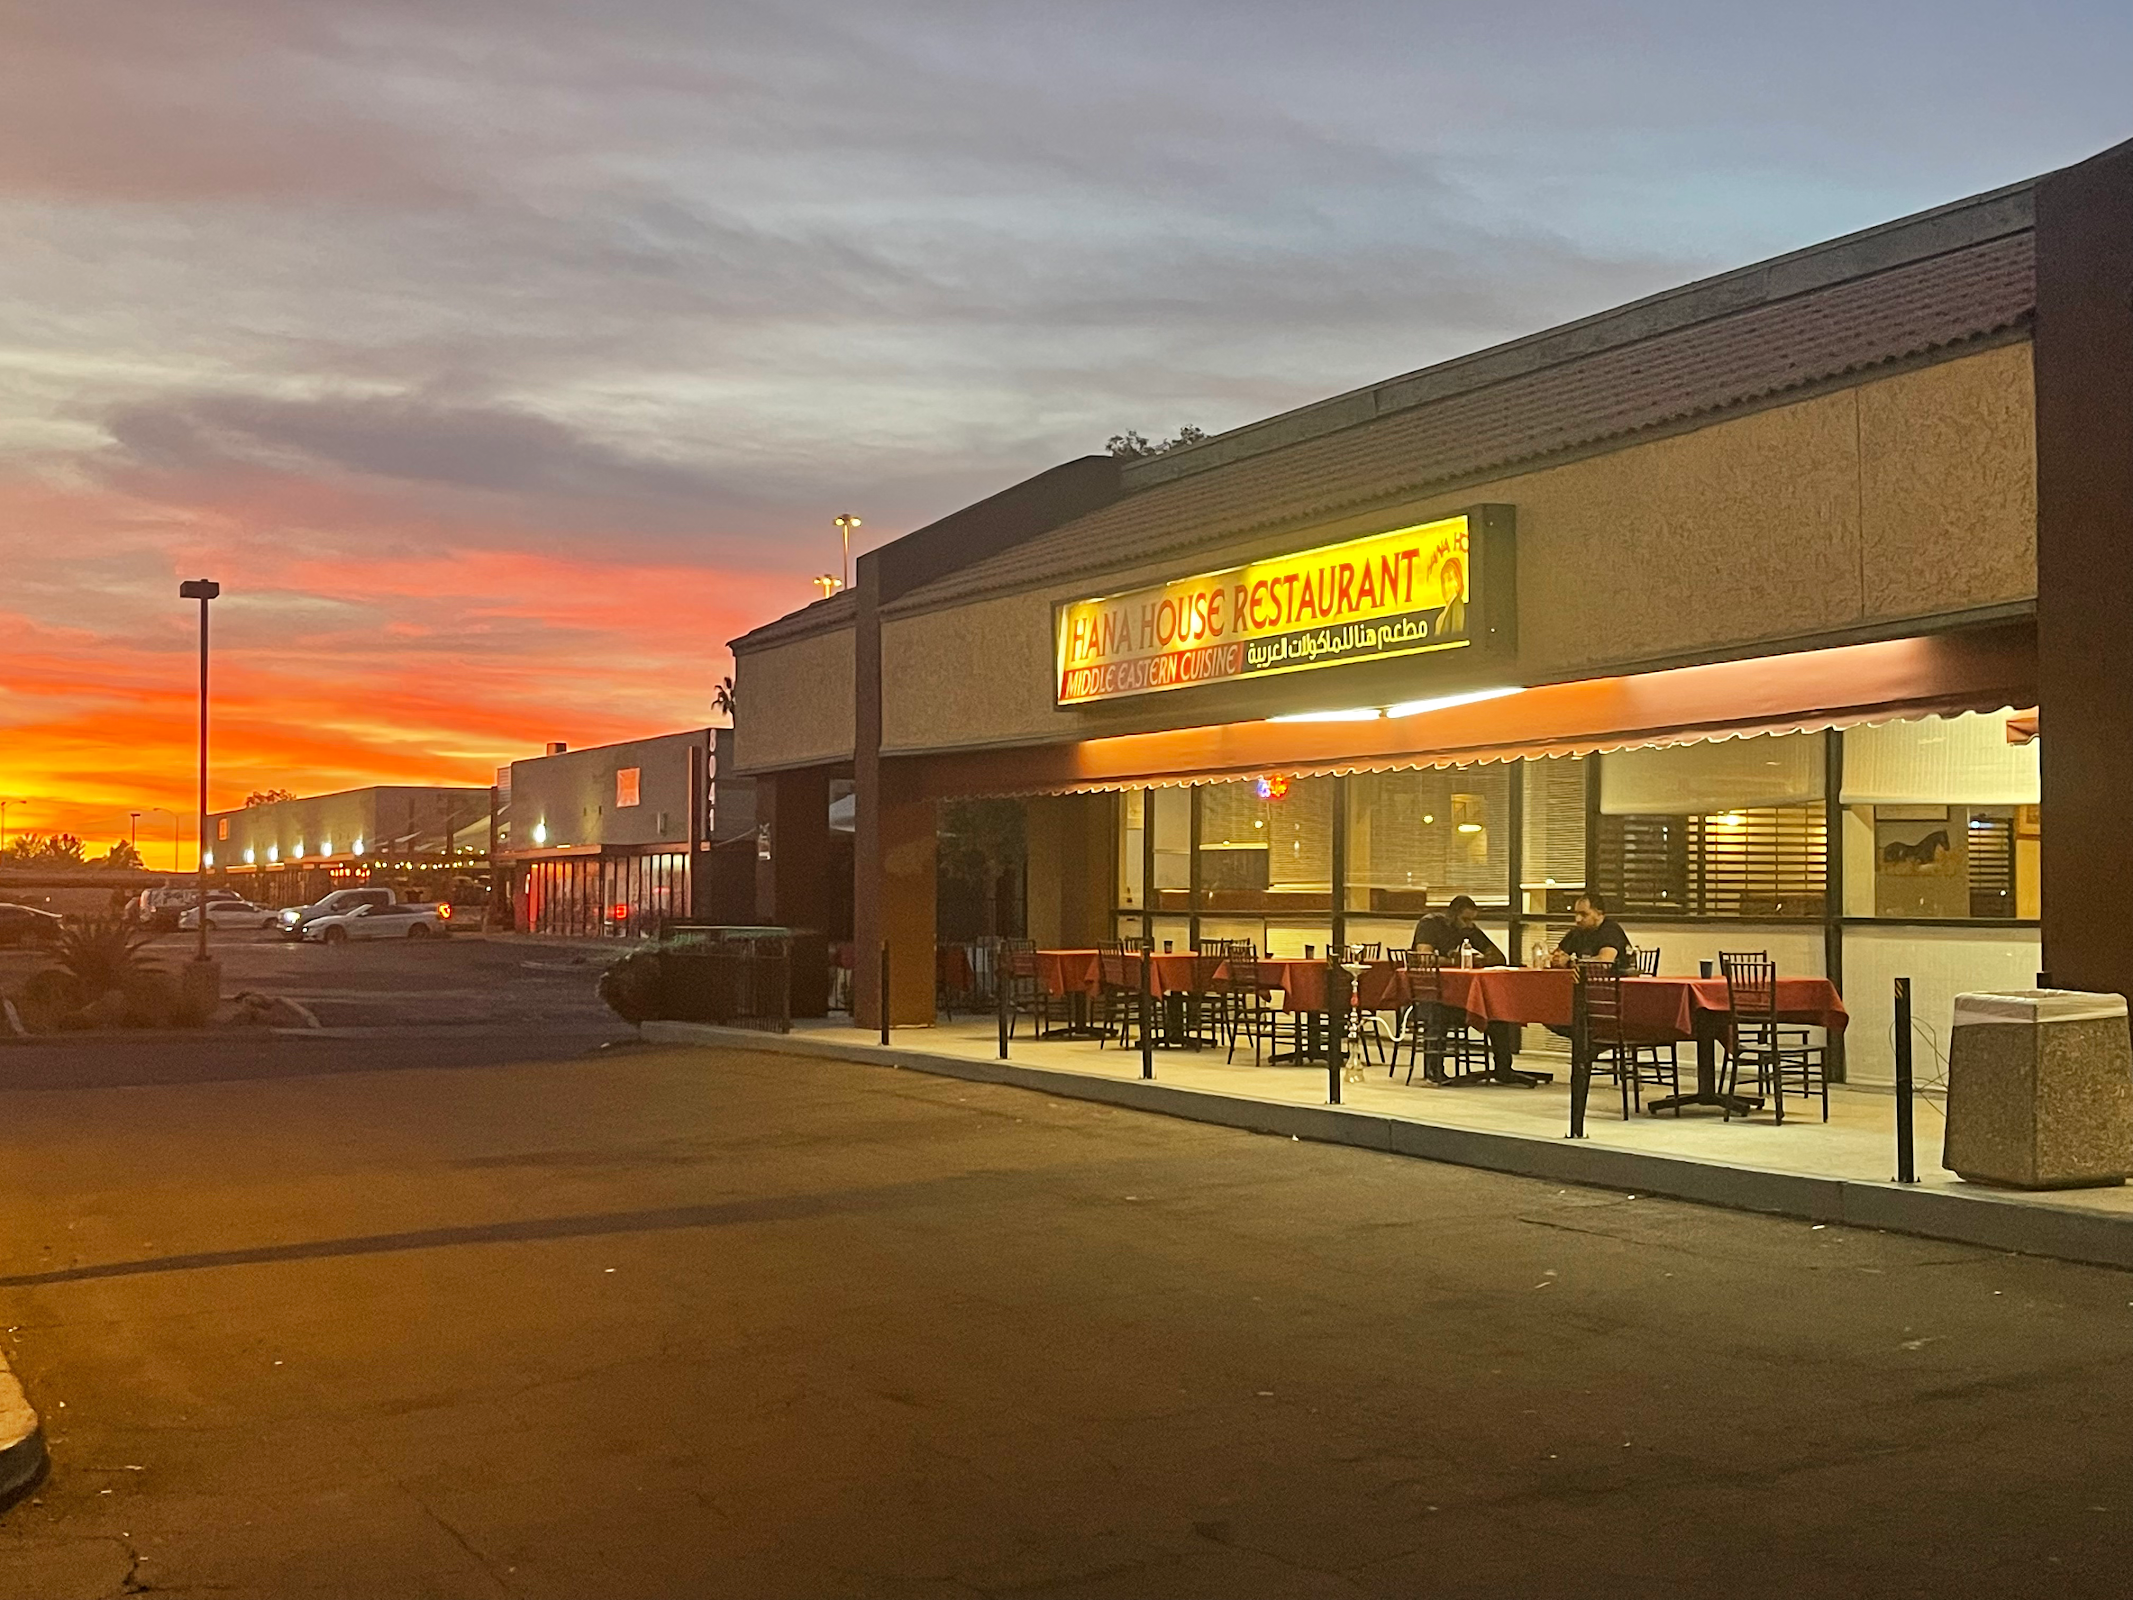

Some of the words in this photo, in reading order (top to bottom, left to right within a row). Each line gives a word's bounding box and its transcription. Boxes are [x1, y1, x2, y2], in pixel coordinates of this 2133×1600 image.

[1071, 608, 1133, 662] HANA
[1139, 589, 1225, 650] HOUSE
[1232, 548, 1419, 633] RESTAURANT
[1247, 637, 1288, 668] العربية
[1377, 617, 1428, 650] مطعم
[1065, 665, 1116, 698] MIDDLE
[1117, 654, 1177, 690] EASTERN
[1180, 645, 1238, 680] CUISINE
[708, 729, 716, 831] 8041
